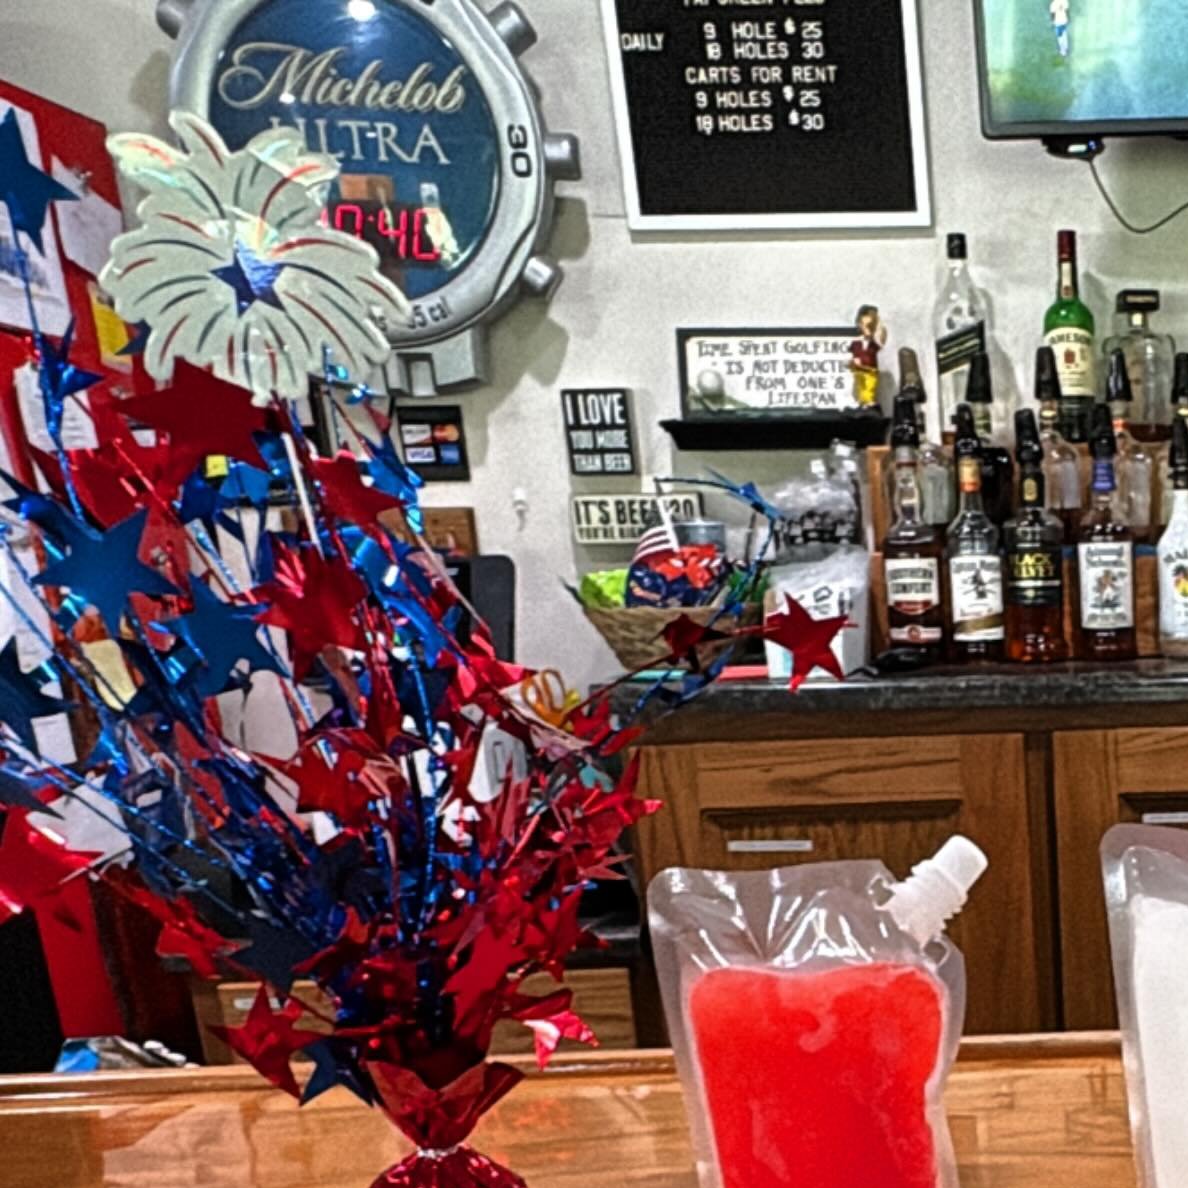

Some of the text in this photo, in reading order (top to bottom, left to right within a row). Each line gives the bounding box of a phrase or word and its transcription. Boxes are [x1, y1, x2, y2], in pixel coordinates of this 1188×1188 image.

[703, 22, 716, 39] 9
[731, 21, 777, 39] HOLE
[621, 33, 664, 51] DAILY
[706, 42, 824, 60] 18 HOLES 30
[218, 42, 467, 113] Michelob
[685, 65, 838, 84] CARTS FOR RENT
[695, 91, 708, 108] 9
[716, 91, 773, 108] HOLES
[696, 115, 713, 135] 18
[718, 115, 773, 131] HOLES
[507, 123, 532, 178] 30
[1046, 332, 1091, 346] AMESON
[697, 340, 851, 357] TIME SPENT GOLFING
[725, 359, 850, 375] IS NOT DEDUCTE
[746, 375, 787, 391] FROM
[768, 391, 837, 406] LIFESPAN
[564, 393, 627, 425] I LOVE
[570, 430, 630, 449] YOU MORE
[573, 453, 632, 472] THAN BEER
[574, 500, 611, 525] IT'S
